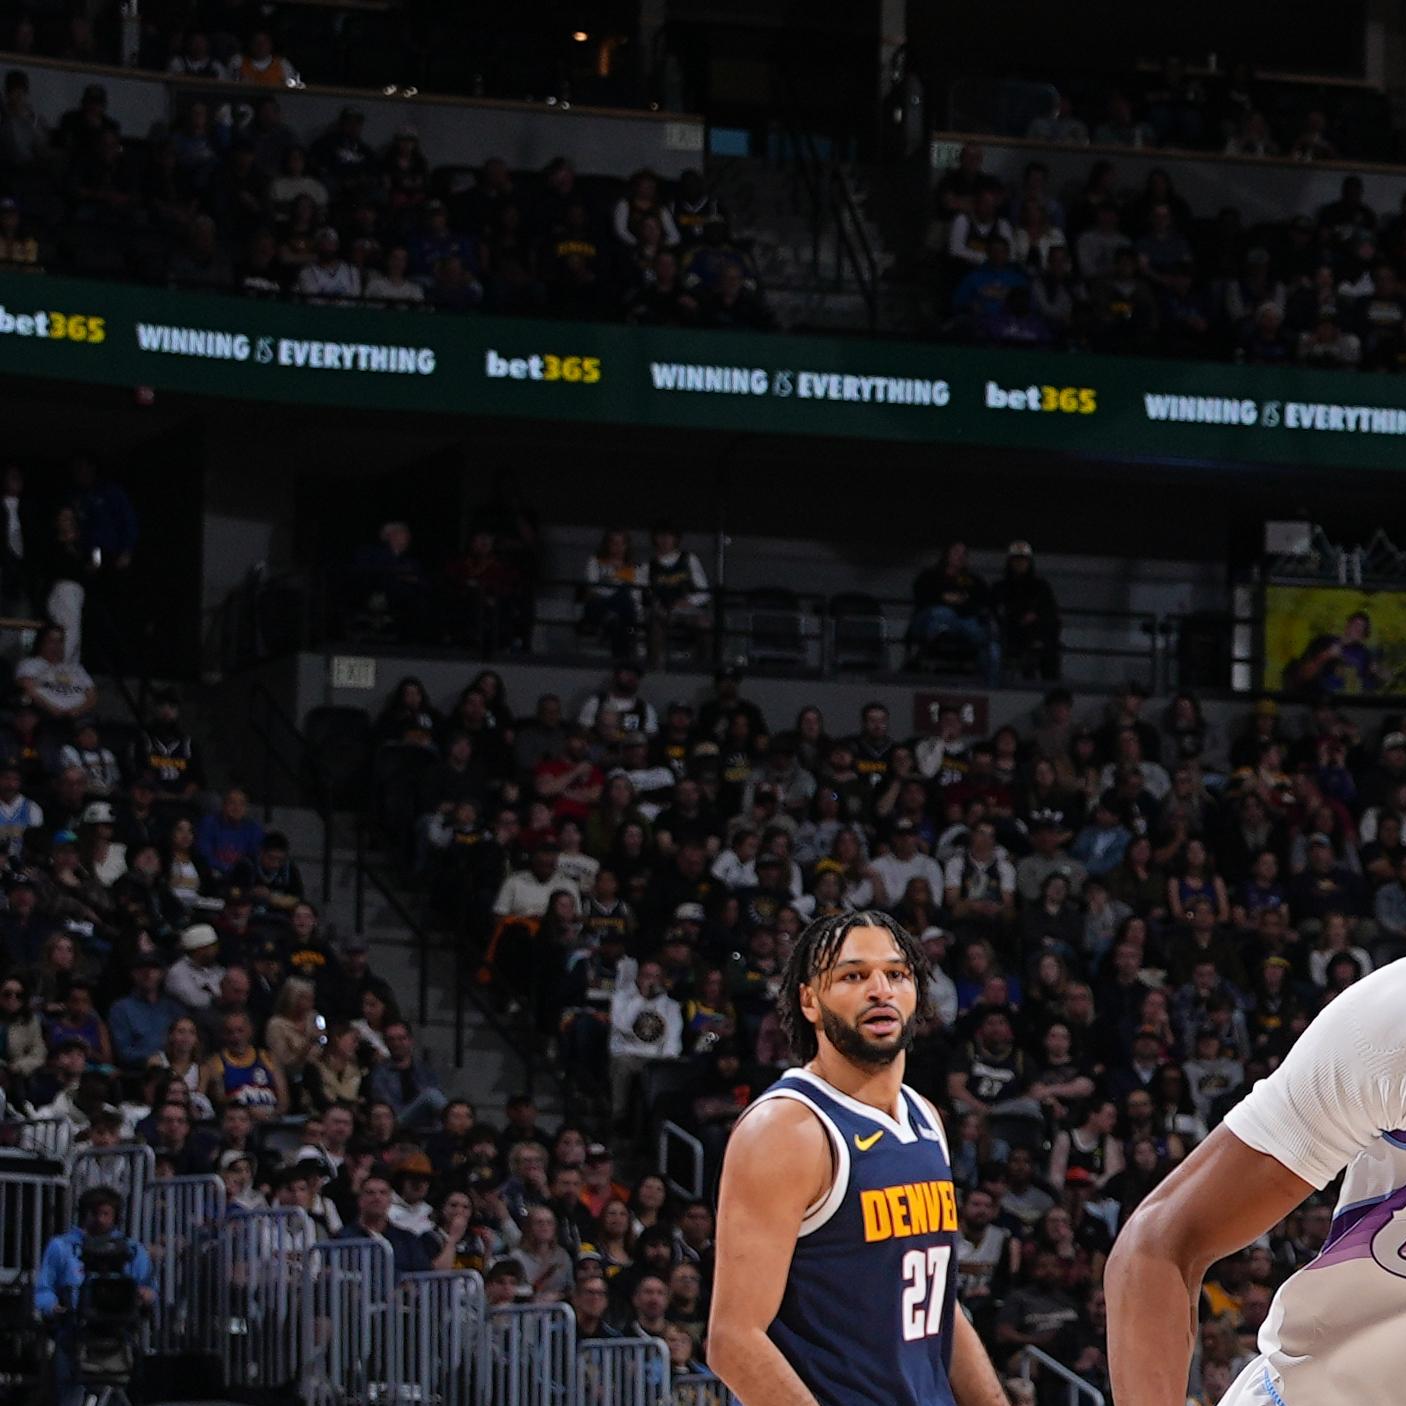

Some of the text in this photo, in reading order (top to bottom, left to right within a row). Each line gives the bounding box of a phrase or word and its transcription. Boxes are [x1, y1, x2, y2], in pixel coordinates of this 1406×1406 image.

[0, 306, 104, 342] bet365
[137, 324, 250, 360] WINNING
[278, 339, 435, 374] EVERYTHING
[486, 351, 599, 382] bet365
[651, 363, 768, 394] WINNING
[797, 372, 949, 406] EVERYTHING
[986, 382, 1096, 412] bet365
[1145, 394, 1257, 425] WINNING
[860, 1180, 958, 1243] DENVE
[901, 1244, 952, 1342] 27
